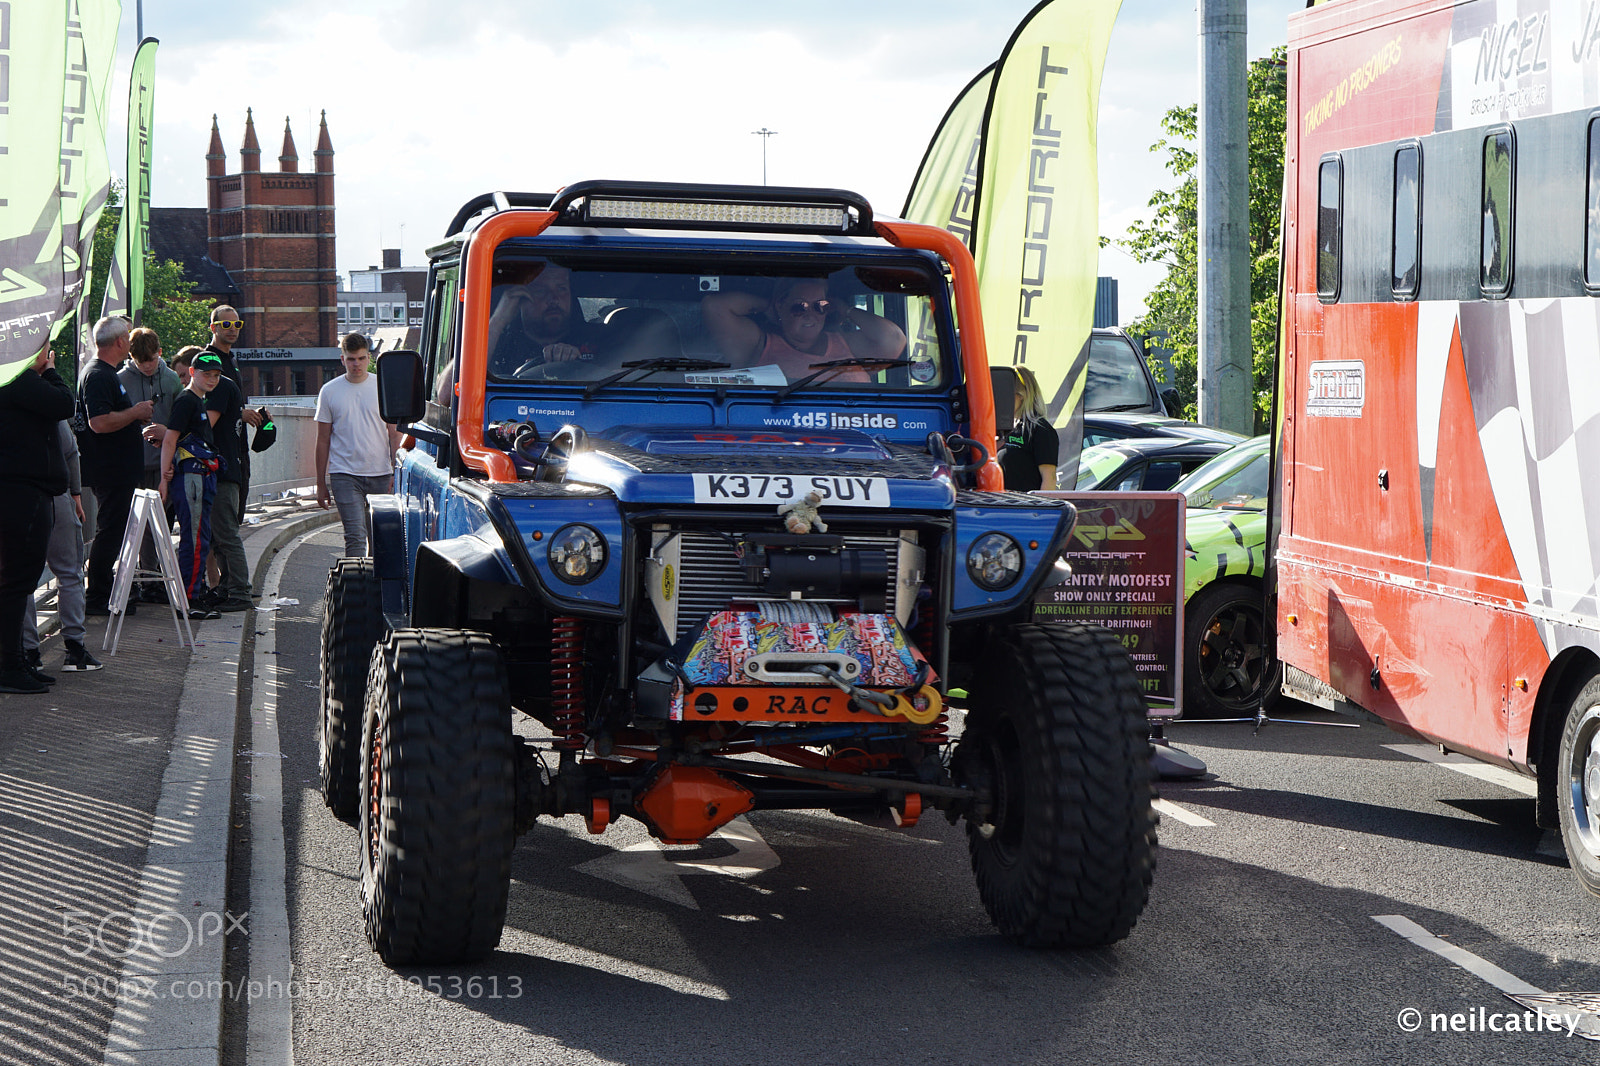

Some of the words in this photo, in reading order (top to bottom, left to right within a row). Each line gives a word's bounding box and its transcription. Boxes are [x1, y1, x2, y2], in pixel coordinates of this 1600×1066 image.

[1475, 11, 1548, 85] NIGEL
[1304, 91, 1334, 136] TAKING
[1335, 77, 1348, 109] NO
[1349, 35, 1402, 100] PRISONERS
[236, 351, 263, 359] Baptist
[265, 350, 293, 358] Church
[529, 407, 575, 416] @racpartsltd
[708, 474, 794, 499] K373
[811, 477, 873, 500] SUY
[1066, 552, 1146, 560] PRODRIFT
[1108, 574, 1171, 587] MOTOFEST
[1054, 592, 1083, 602] SHOW
[1086, 592, 1112, 602] ONLY
[1115, 591, 1156, 602] SPECIAL!
[1035, 605, 1091, 615] ADRENALINE
[1093, 606, 1118, 615] DRIFT
[1121, 606, 1173, 616] EXPERIENCE
[1107, 619, 1152, 629] DRIFTING!!
[1129, 653, 1158, 661] NTRIES!
[1135, 664, 1168, 672] CONTROL!
[765, 695, 831, 715] RAC
